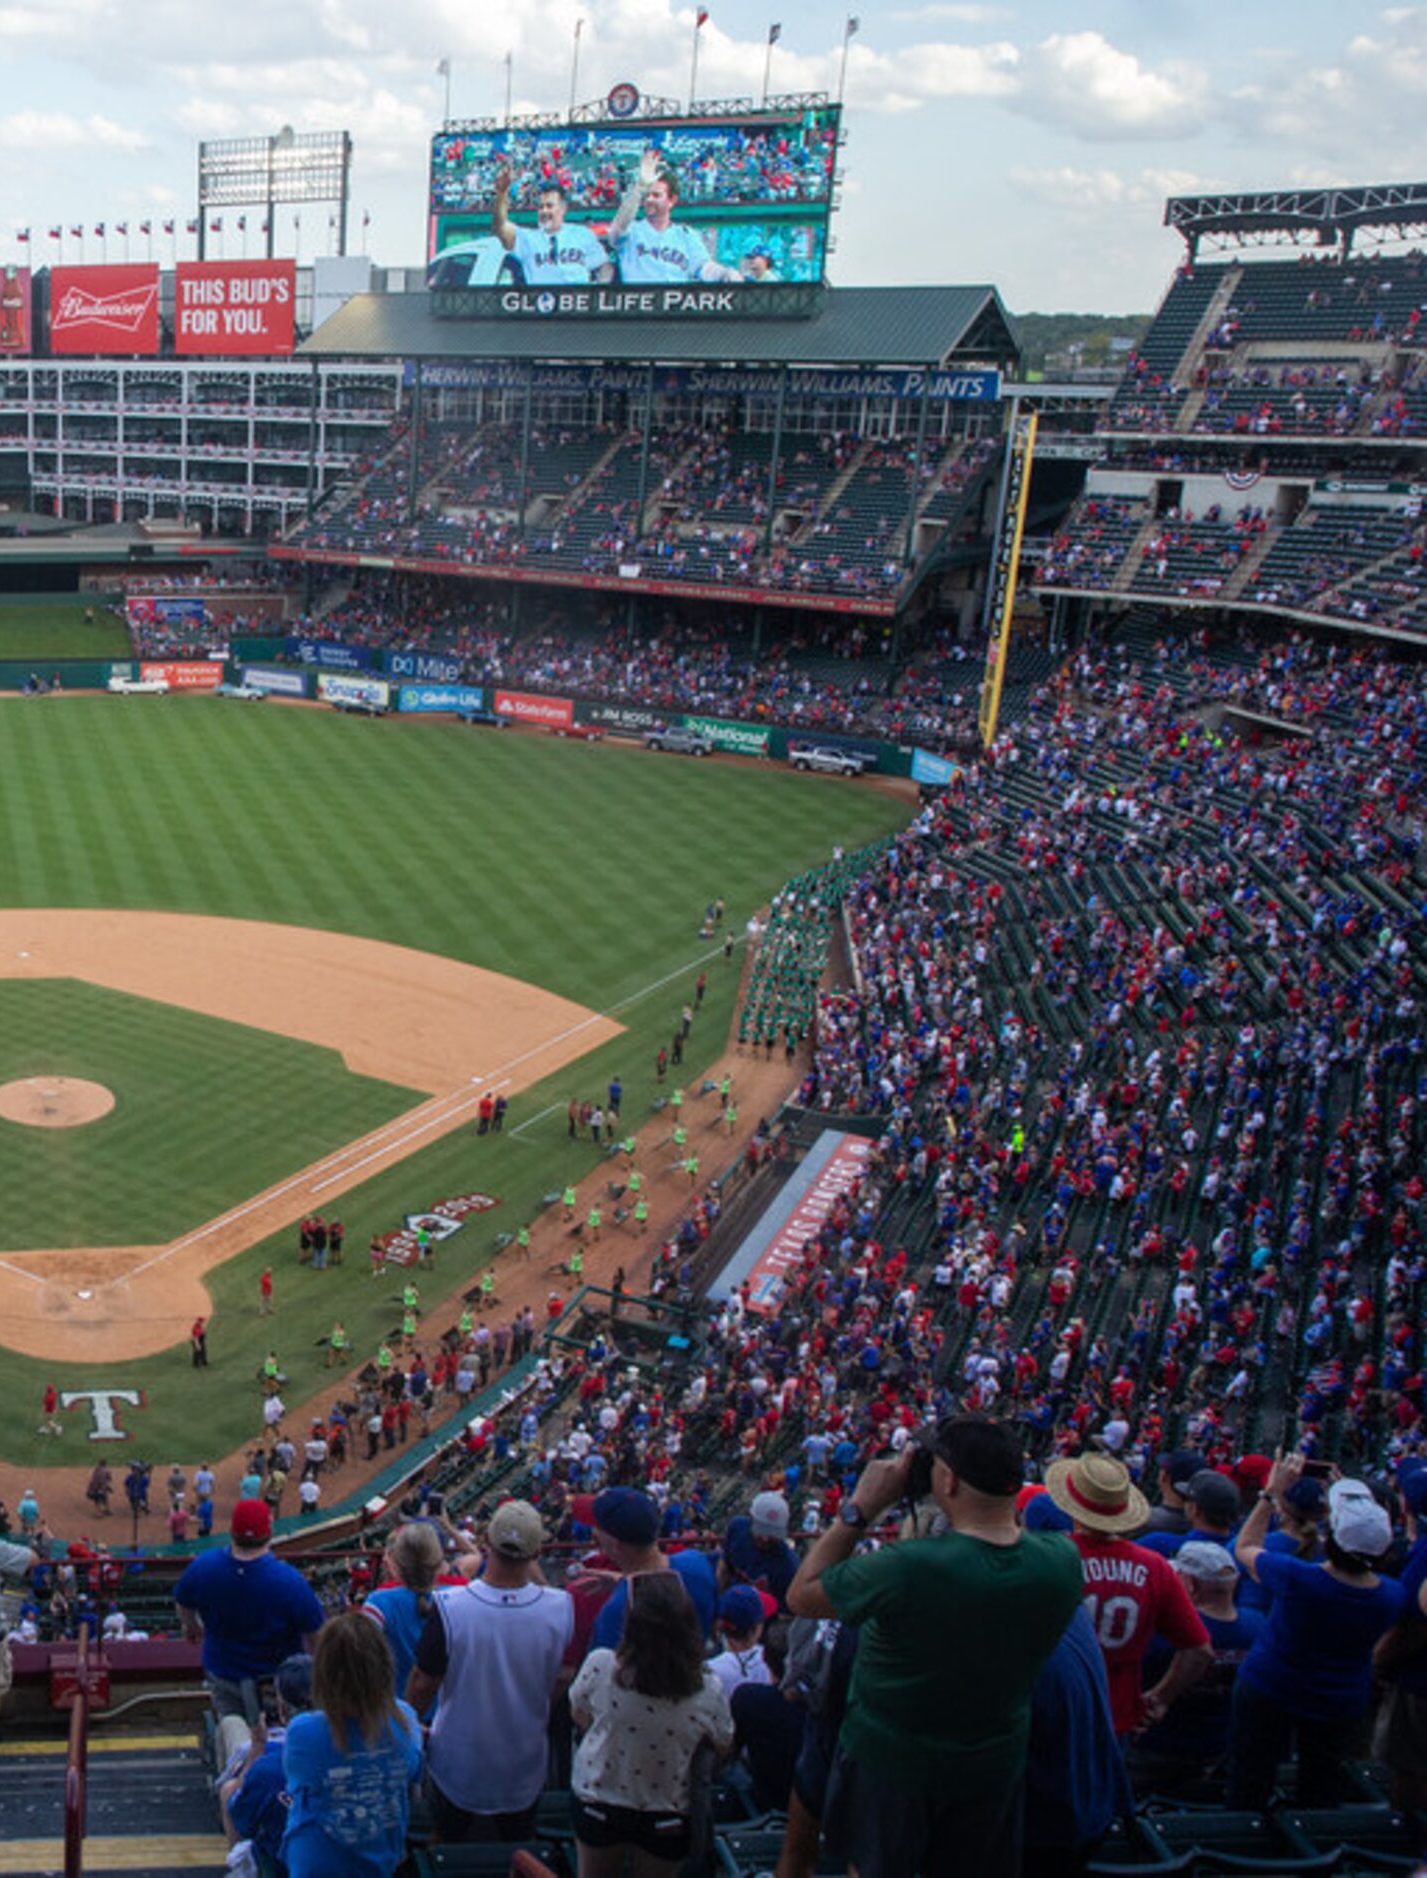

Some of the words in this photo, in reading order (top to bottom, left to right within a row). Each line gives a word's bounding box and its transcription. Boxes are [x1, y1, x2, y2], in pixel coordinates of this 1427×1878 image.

[180, 280, 225, 304] THIS
[229, 278, 289, 303] BUD'S
[501, 291, 590, 314] GLOBE
[598, 291, 655, 313] LIFE
[662, 289, 735, 312] PARK
[60, 297, 146, 319] Budweiser
[180, 309, 224, 335] FOR
[224, 308, 268, 334] YOU.
[589, 367, 650, 389] PAINT
[902, 372, 985, 398] PAINTS
[703, 723, 768, 744] National
[765, 1218, 822, 1268] TEXAS
[60, 1388, 142, 1441] T
